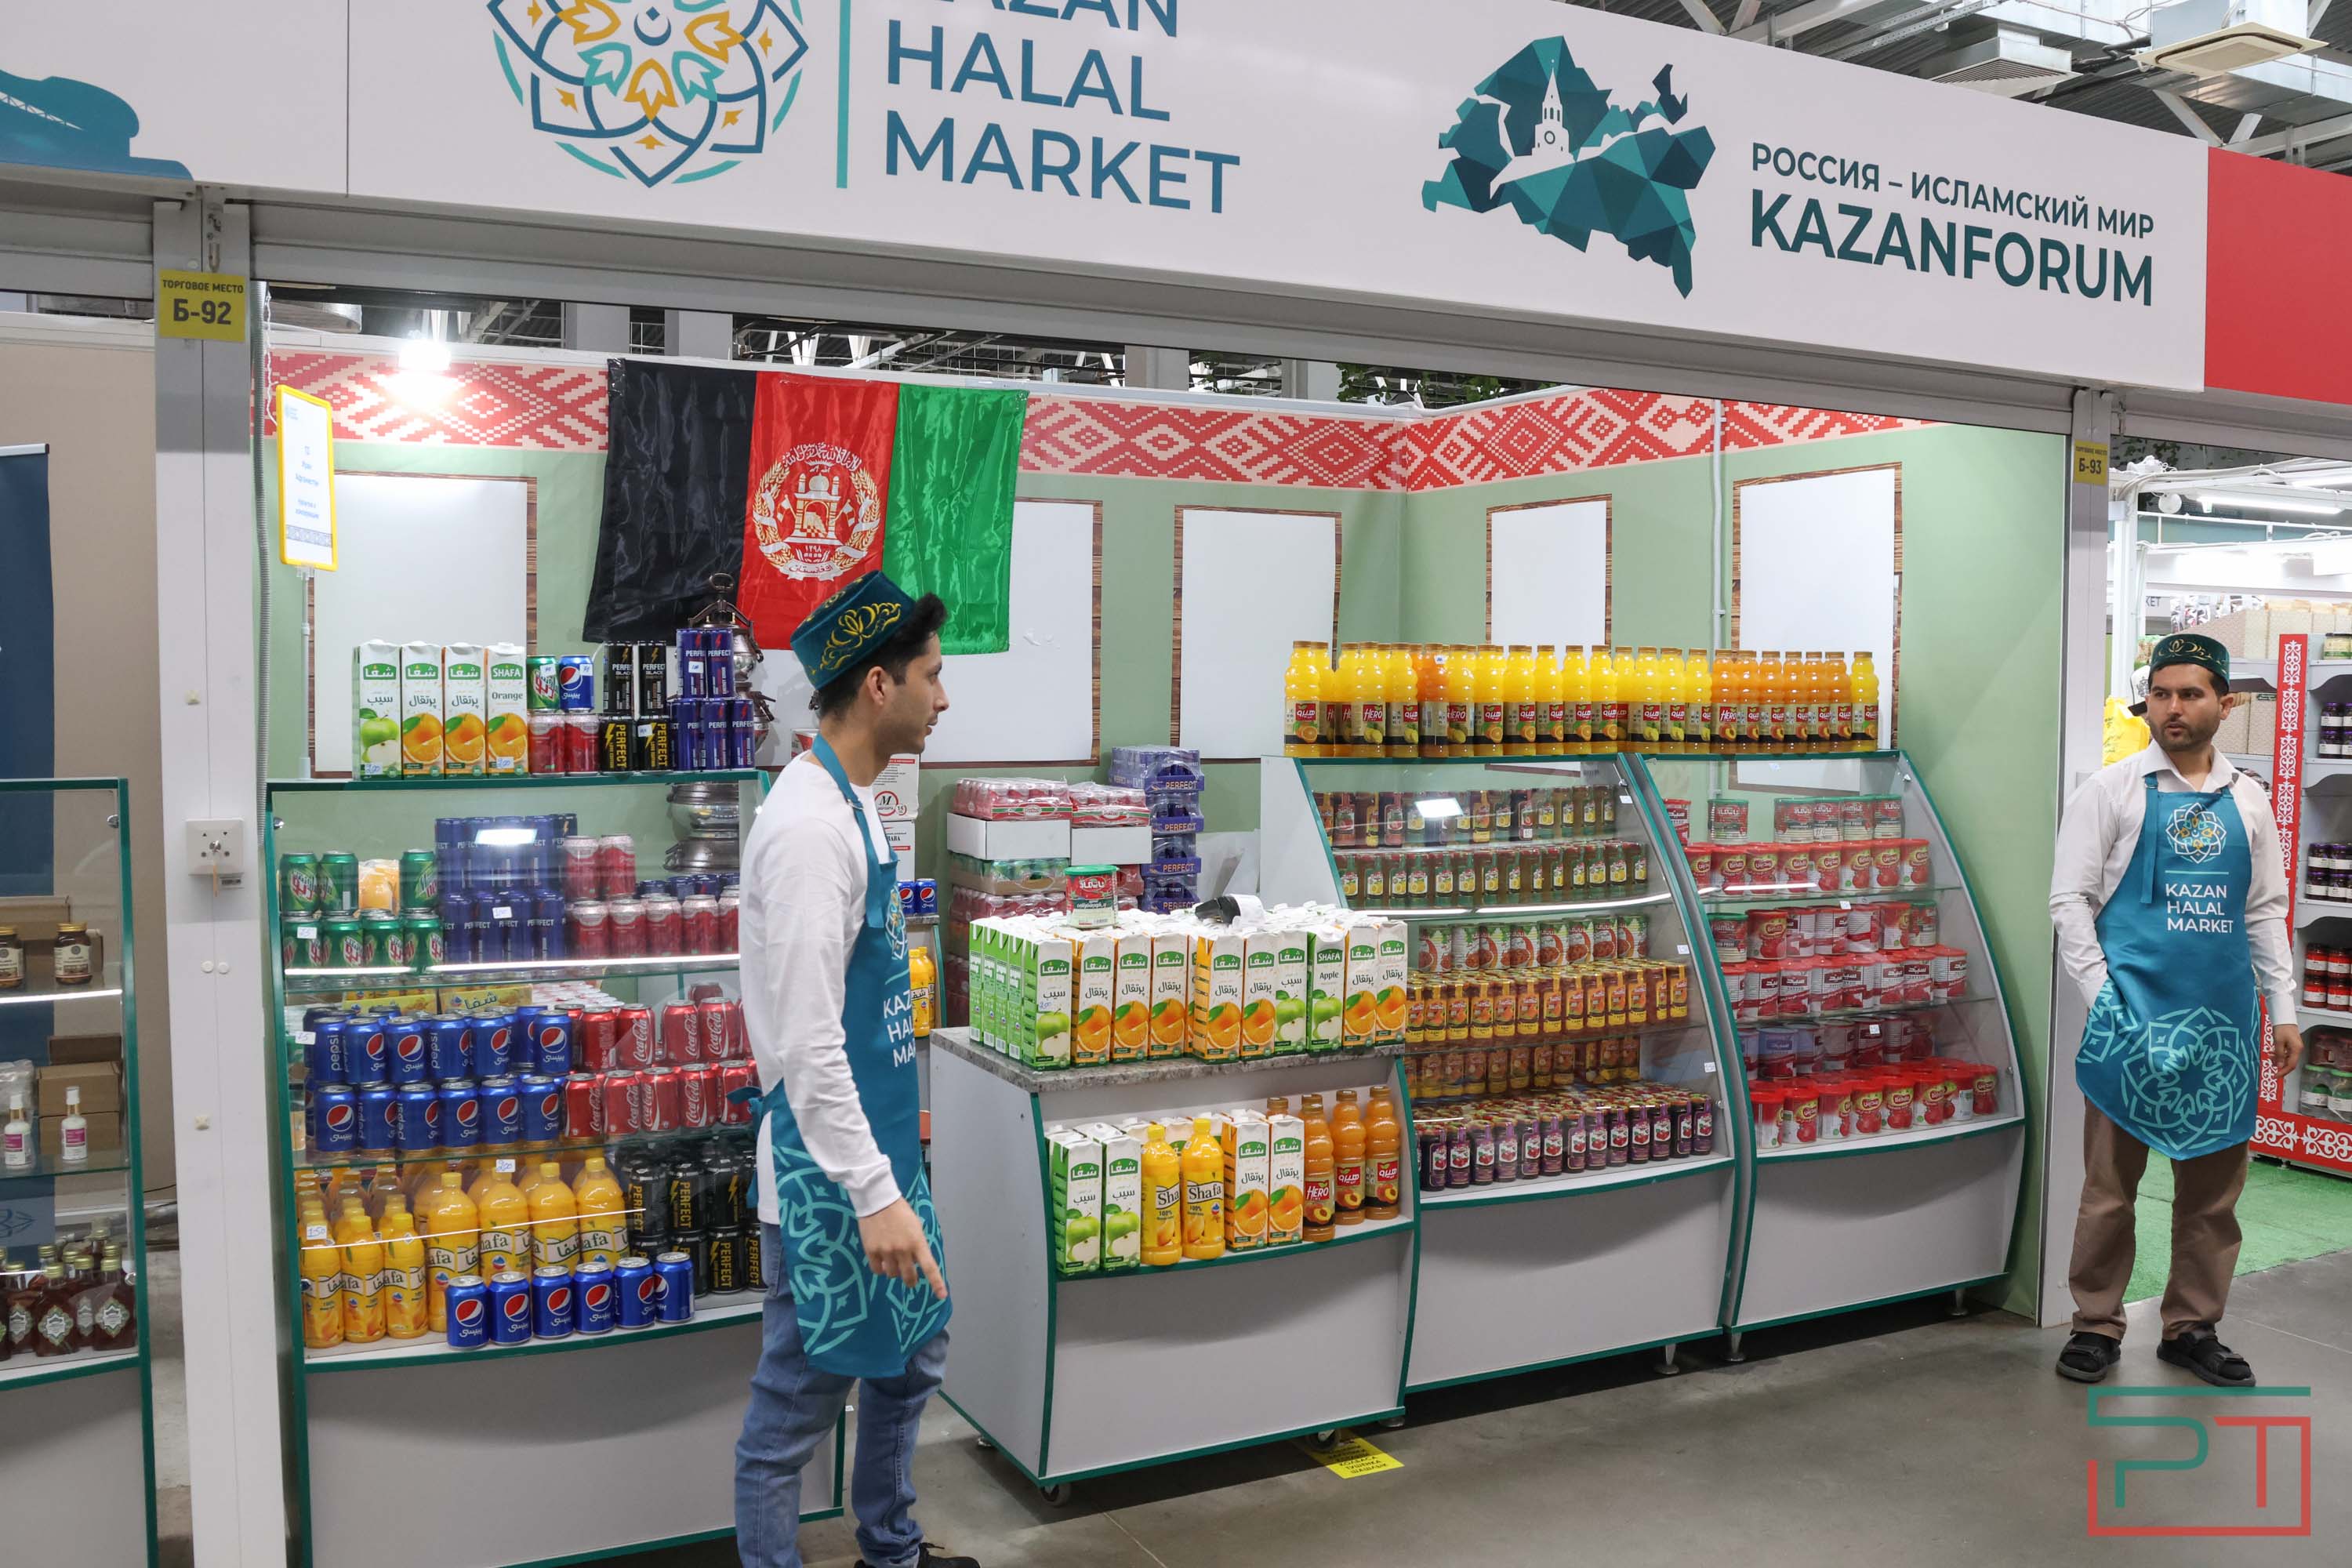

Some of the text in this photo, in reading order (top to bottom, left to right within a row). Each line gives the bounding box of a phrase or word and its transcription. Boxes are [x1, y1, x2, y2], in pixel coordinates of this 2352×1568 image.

[887, 20, 1171, 122] HALAL
[886, 110, 1241, 214] MARKET
[1752, 142, 1879, 192] РОССИЯ
[1911, 171, 2089, 230] ИСЛАМСКИЙ
[2097, 206, 2154, 239] МИР
[1751, 188, 2152, 307] KAZANFORUM
[162, 279, 244, 293] ТОРГОВОЕ МЕСТО
[173, 298, 231, 325] Б-92
[2078, 457, 2102, 475] Б-93
[493, 668, 521, 677] SHAFA
[409, 695, 436, 708] پرتقال
[452, 695, 478, 708] پرتقال
[492, 691, 523, 701] Orange
[1364, 709, 1382, 721] HERO
[616, 724, 627, 768] PERFECT
[658, 724, 667, 766] PERFECT
[1166, 781, 1197, 789] PERFECT
[1163, 864, 1195, 873] PERFECT
[2165, 884, 2227, 898] KAZAN
[2167, 902, 2225, 915] HALAL
[2167, 918, 2233, 933] MARKET
[1318, 951, 1341, 961] SHAFA
[1352, 974, 1374, 985] پرتقال
[1383, 968, 1403, 980] پرتقال
[1085, 988, 1108, 1000] پرتقال
[1122, 985, 1145, 996] پرتقال
[1158, 982, 1181, 993] پرتقال
[1215, 985, 1237, 996] پرتقال
[1250, 982, 1272, 994] پرتقال
[633, 1017, 647, 1062] Coca-Cola
[707, 1012, 722, 1055] Coca-Cola
[328, 1034, 342, 1071] pepsi
[685, 1080, 700, 1123] Coca-Cola
[1241, 1171, 1264, 1184] پرتقال
[1276, 1167, 1298, 1179] پرتقال
[1189, 1184, 1221, 1200] Shafa
[1307, 1186, 1329, 1199] HERO
[681, 1181, 691, 1229] PERFECT
[721, 1242, 731, 1287] PERFECT
[750, 1240, 759, 1285] PERFECT
